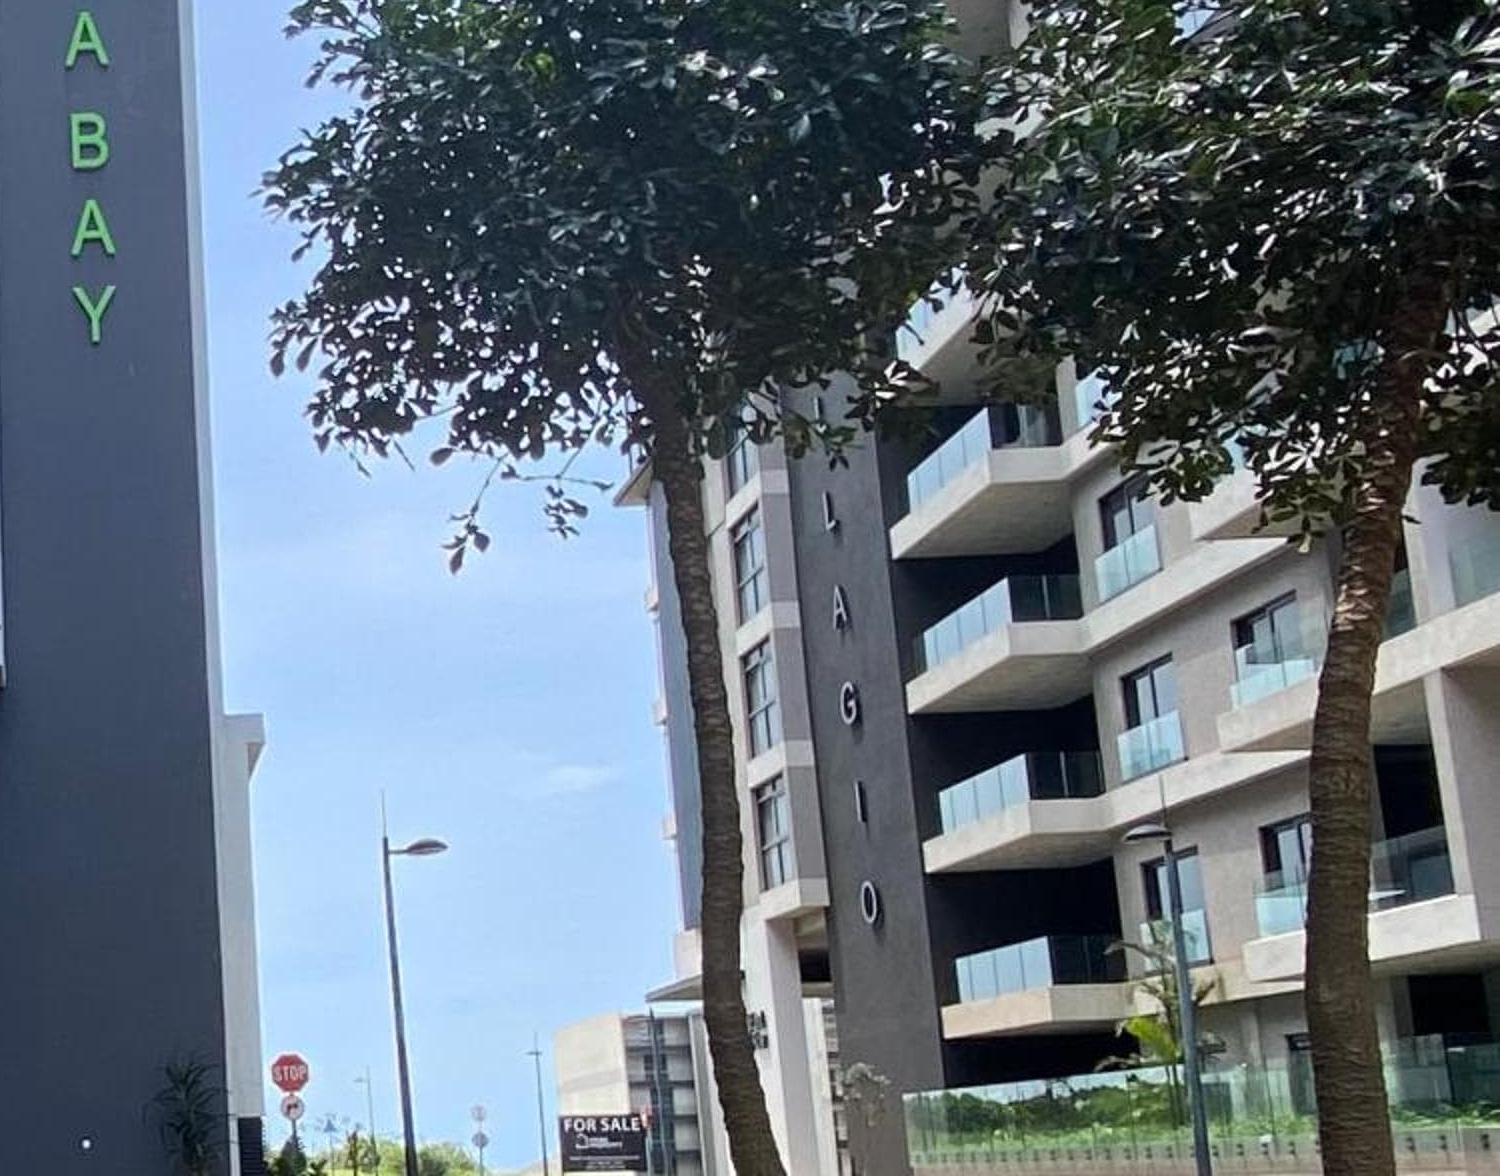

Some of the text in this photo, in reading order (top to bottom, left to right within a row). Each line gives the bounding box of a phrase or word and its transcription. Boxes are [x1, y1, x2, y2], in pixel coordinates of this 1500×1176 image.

[68, 111, 117, 345] BAY
[812, 395, 880, 925] LLAGIO
[274, 1064, 307, 1082] STOP
[563, 1117, 641, 1133] FOR SALE
